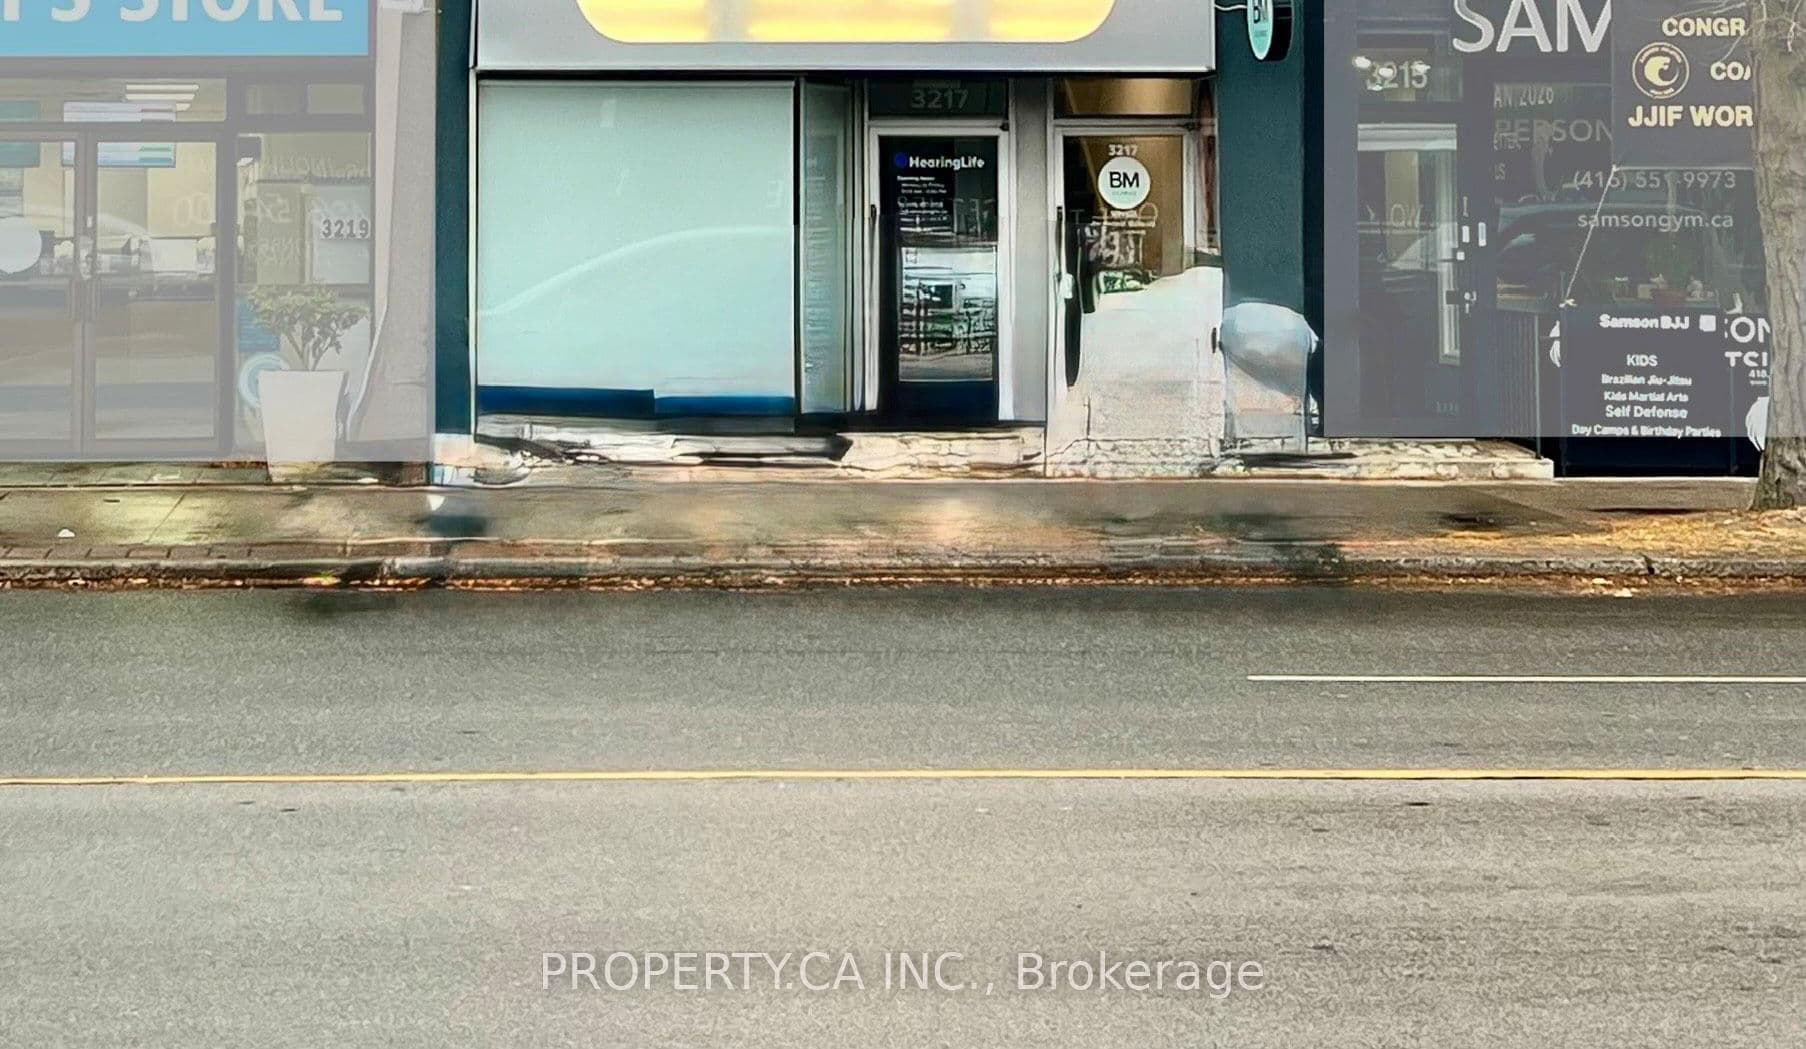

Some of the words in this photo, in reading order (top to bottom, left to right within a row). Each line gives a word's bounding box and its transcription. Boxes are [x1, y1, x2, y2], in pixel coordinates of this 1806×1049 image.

[1661, 17, 1746, 37] CONGR
[911, 89, 968, 110] 3217
[1628, 105, 1683, 127] JJIF
[1689, 105, 1753, 127] WOR
[1108, 144, 1138, 156] 3217
[909, 156, 985, 170] HearingLife
[1109, 171, 1139, 188] BM
[322, 219, 369, 238] 3219
[1577, 213, 1734, 232] samsongym.ca
[1599, 313, 1659, 329] Samson
[1660, 316, 1690, 330] BJJ
[1626, 354, 1658, 367] KIDS
[1601, 373, 1646, 385] Brazilian
[1604, 391, 1627, 402] Kids
[1628, 391, 1665, 402] Martial
[1605, 405, 1630, 418] Self
[1633, 406, 1688, 419] Defense
[1571, 424, 1592, 436] Day
[1594, 424, 1629, 437] Camps
[1640, 425, 1684, 439] Birthday
[1685, 426, 1722, 438] Parties
